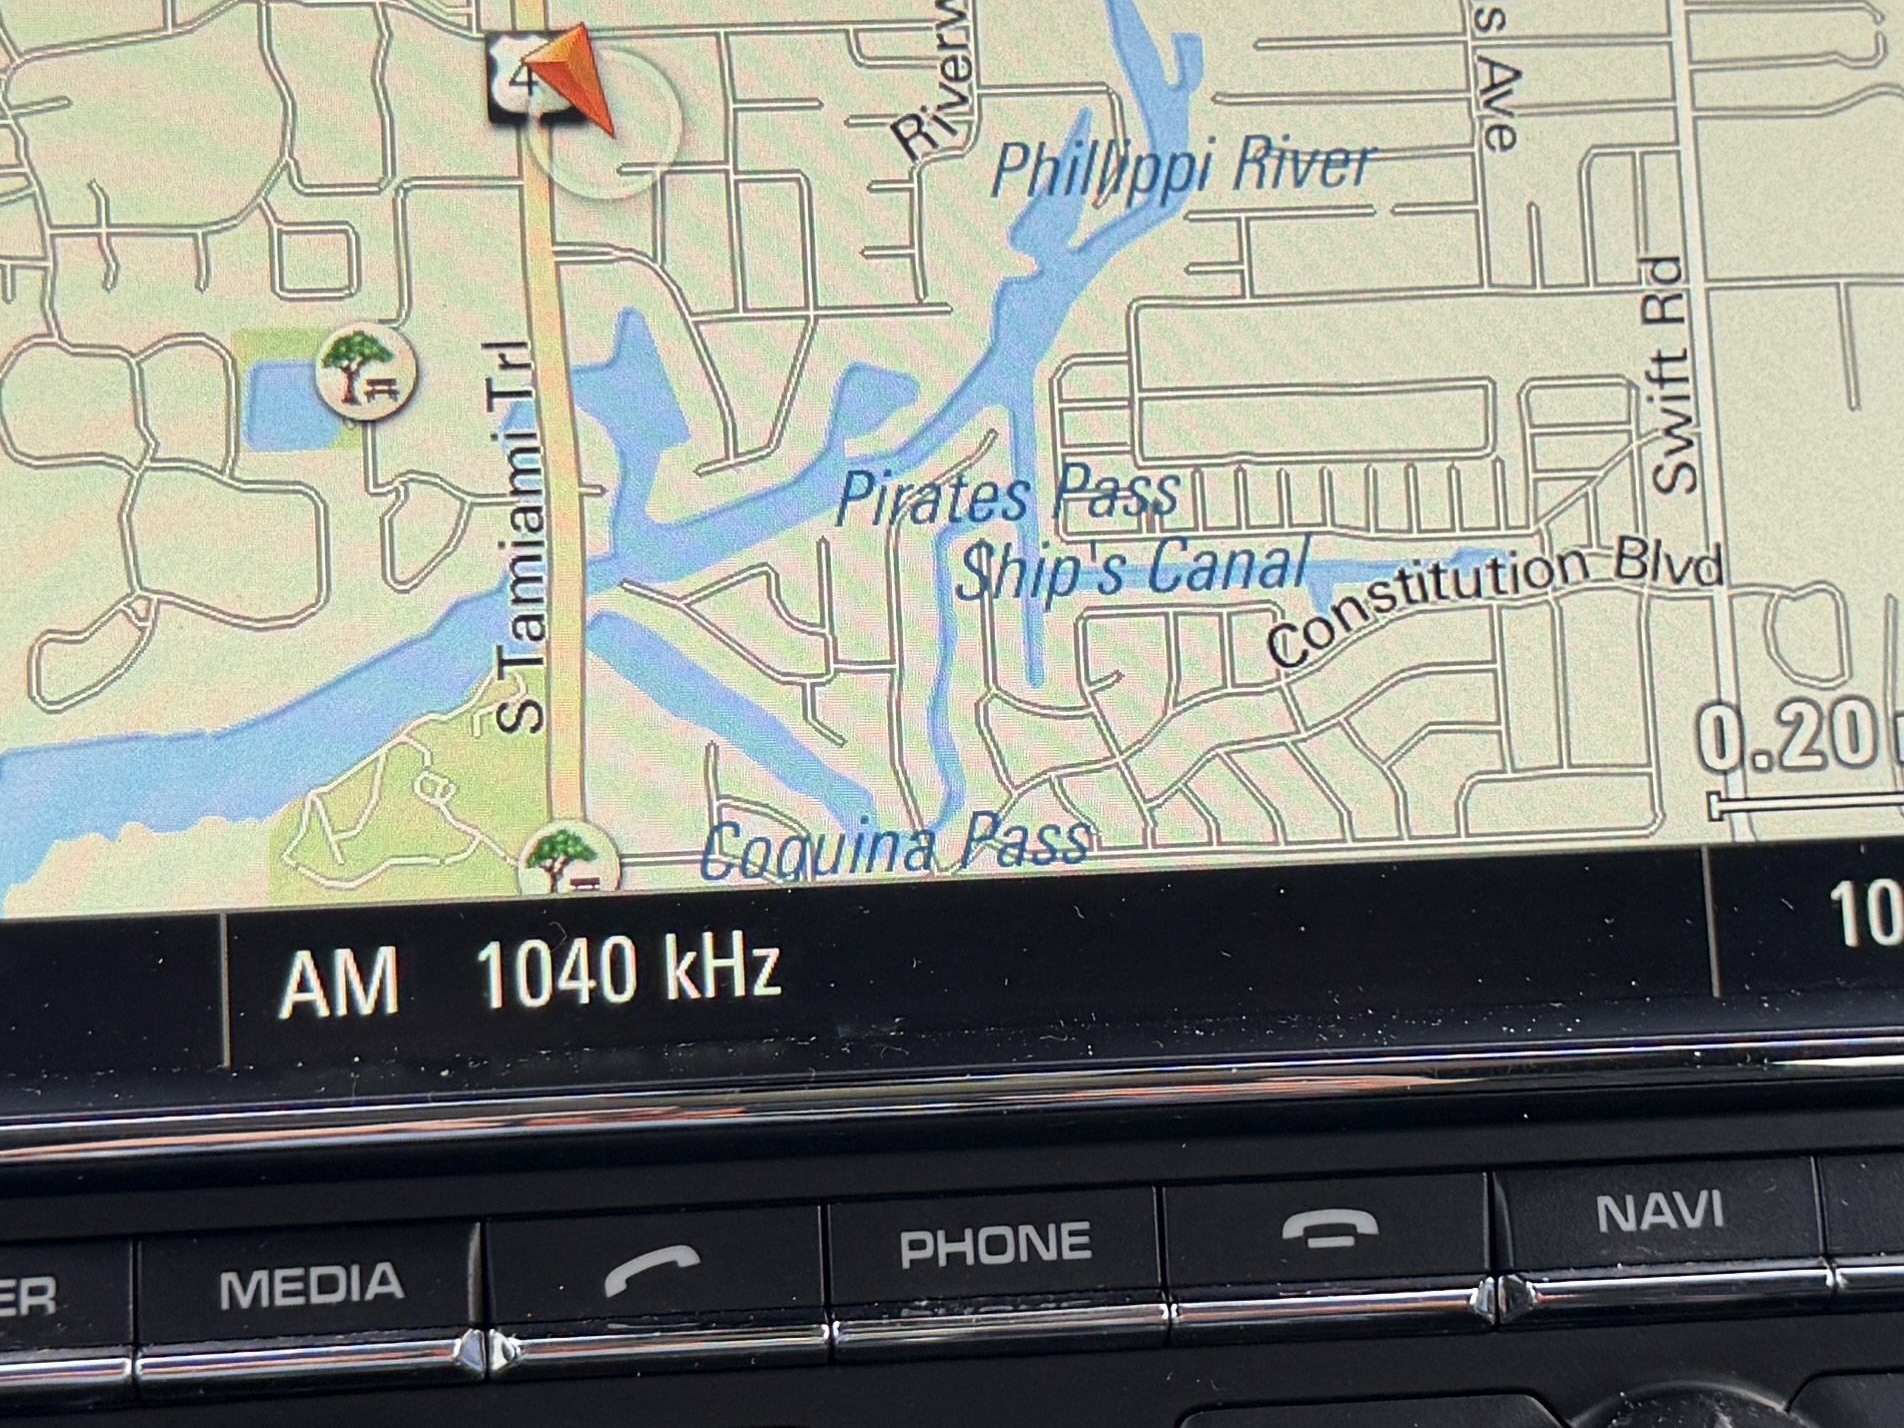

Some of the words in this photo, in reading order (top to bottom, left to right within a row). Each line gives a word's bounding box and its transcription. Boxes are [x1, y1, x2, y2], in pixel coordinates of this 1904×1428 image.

[509, 58, 539, 96] 4
[1476, 54, 1523, 153] Ave
[990, 135, 1217, 208] Phillippi
[1232, 133, 1380, 191] River
[1637, 256, 1685, 325] Rd
[481, 342, 534, 412] Trl
[1644, 348, 1697, 494] Swift
[835, 469, 1031, 527] Pirates
[1052, 462, 1181, 520] Pass
[490, 431, 547, 680] Tamiami
[955, 538, 1127, 611] Ship's
[1148, 533, 1311, 593] Canal
[1267, 547, 1590, 670] Constitution
[1613, 534, 1726, 588] Blvd
[496, 698, 544, 734] S
[1696, 696, 1877, 772] 0.20
[701, 815, 936, 881] Coquina
[961, 810, 1094, 869] Pass
[279, 946, 398, 1019] AM
[479, 935, 637, 1009] 1040
[666, 928, 784, 1002] kHz
[900, 1221, 1093, 1269] PHONE
[1597, 1188, 1724, 1234] NAVI
[220, 1262, 406, 1310] MEDIA
